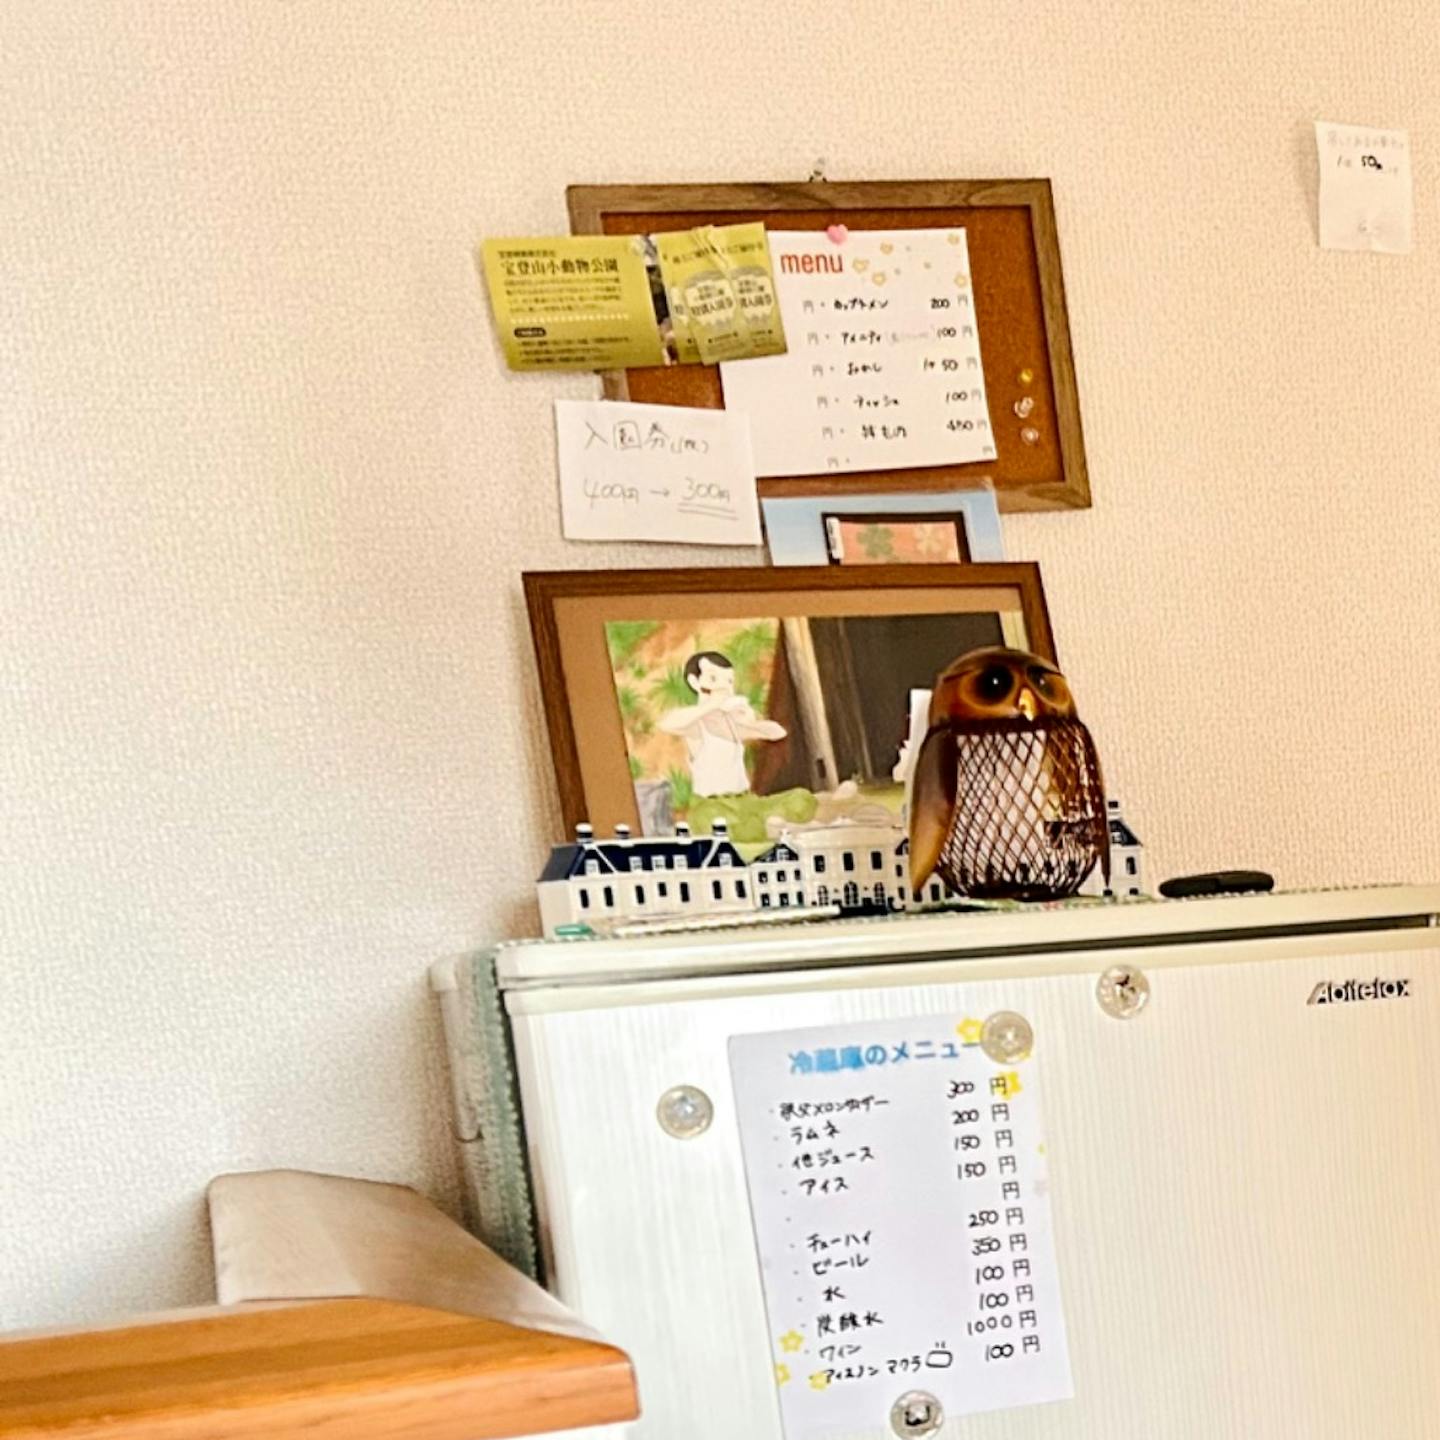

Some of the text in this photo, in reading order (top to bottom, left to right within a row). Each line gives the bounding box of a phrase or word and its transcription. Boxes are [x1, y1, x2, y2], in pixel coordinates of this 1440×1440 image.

[503, 257, 620, 277] 宝登山小動物公園
[780, 253, 844, 274] menu
[788, 1041, 981, 1075] 冷蔵庫のメニュー
[946, 1081, 975, 1099] 300
[791, 1120, 840, 1145] ラムネ
[953, 1109, 980, 1125] 200
[954, 1135, 980, 1150] 150
[800, 1176, 849, 1196] アイス
[957, 1162, 986, 1179] 150
[1002, 1181, 1020, 1200] 円
[807, 1230, 872, 1253] チューハイ
[968, 1209, 999, 1228] 250
[812, 1253, 870, 1276] ビール
[971, 1236, 1001, 1256] 350
[822, 1285, 846, 1301] 水
[975, 1265, 1005, 1285] 100
[979, 1292, 1009, 1311] 100
[819, 1344, 862, 1362] ワイン
[967, 1314, 1012, 1336] 1000
[984, 1342, 1014, 1363] 100
